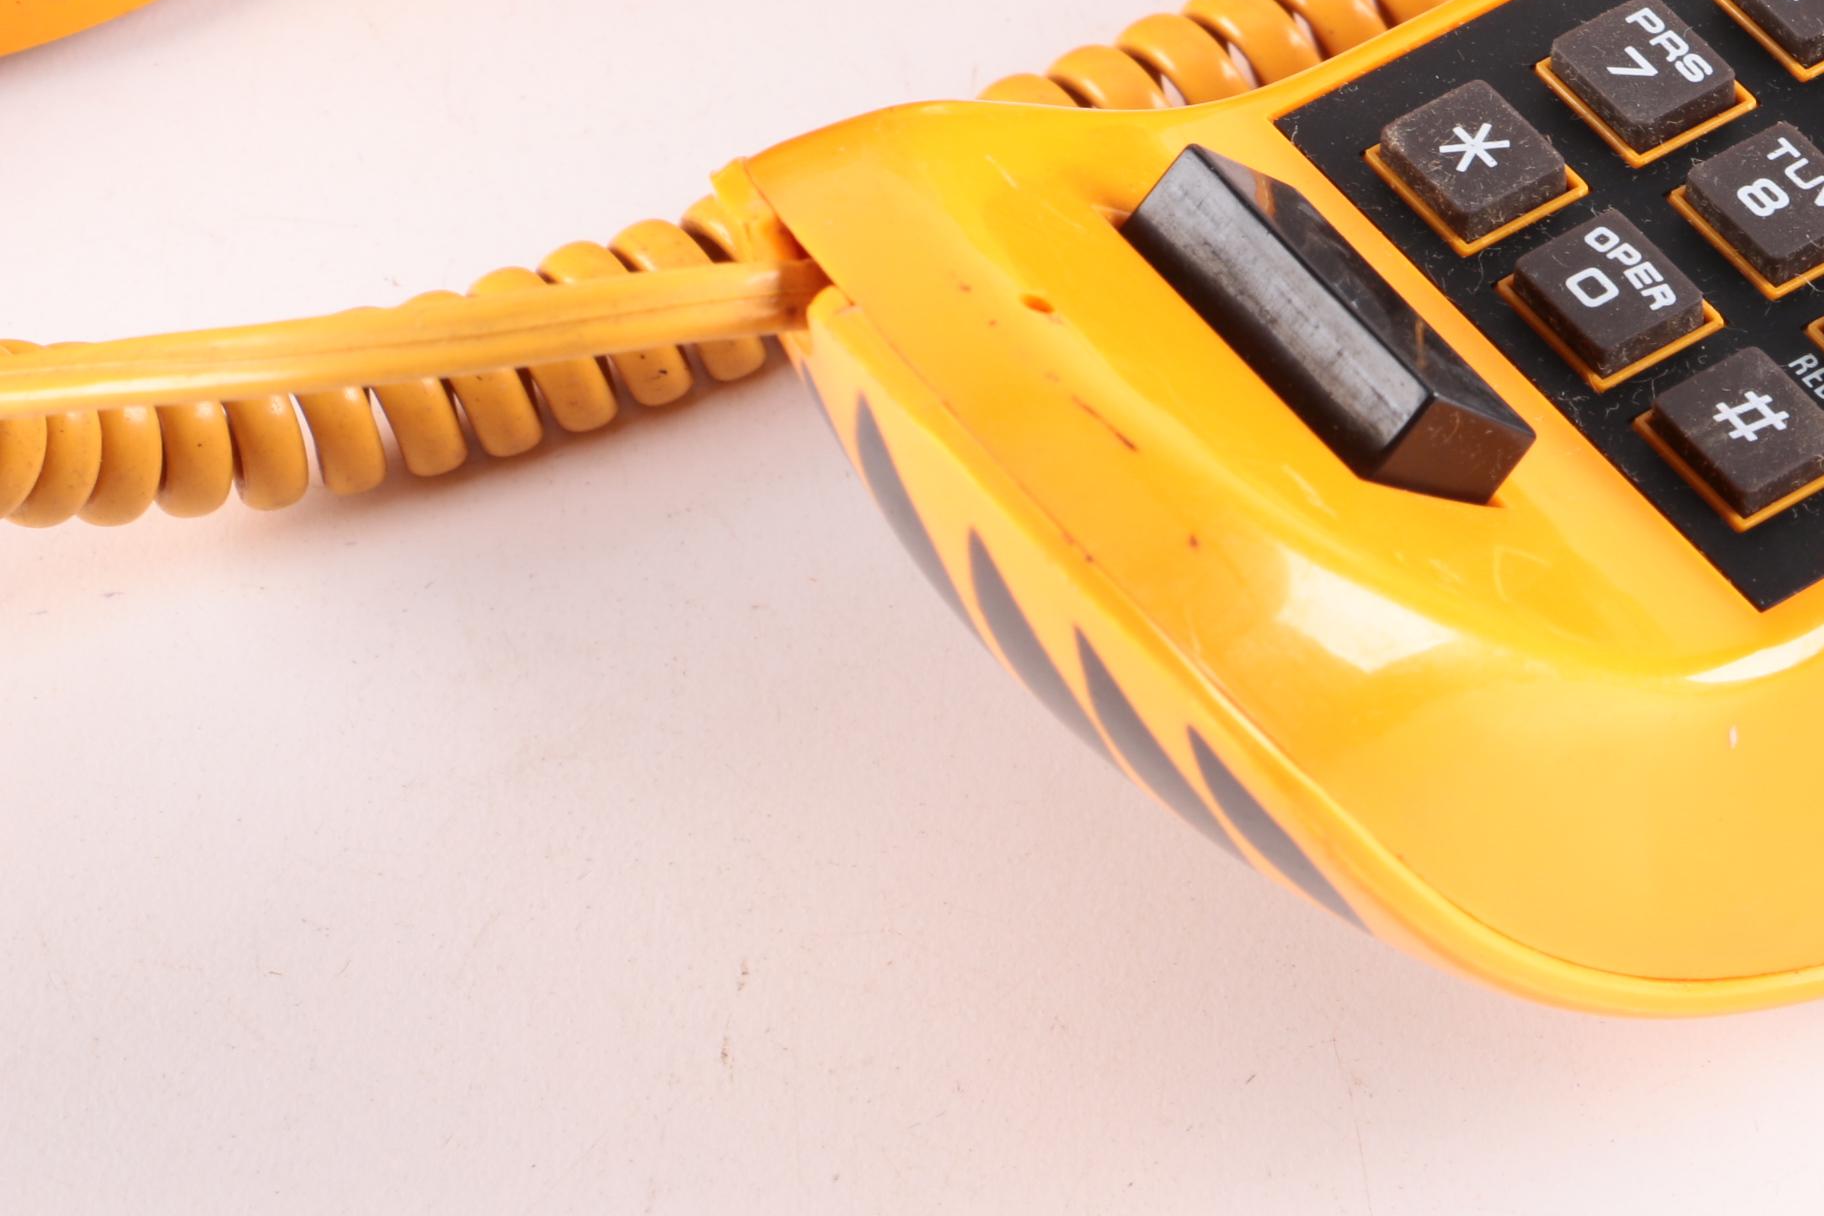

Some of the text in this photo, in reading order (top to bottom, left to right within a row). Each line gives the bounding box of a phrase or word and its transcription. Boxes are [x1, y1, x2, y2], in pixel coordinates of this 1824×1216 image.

[1606, 45, 1659, 77] 7
[1624, 7, 1714, 83] PRS
[1736, 177, 1790, 217] 8
[1565, 267, 1620, 308] 0
[1584, 226, 1677, 311] OPER
